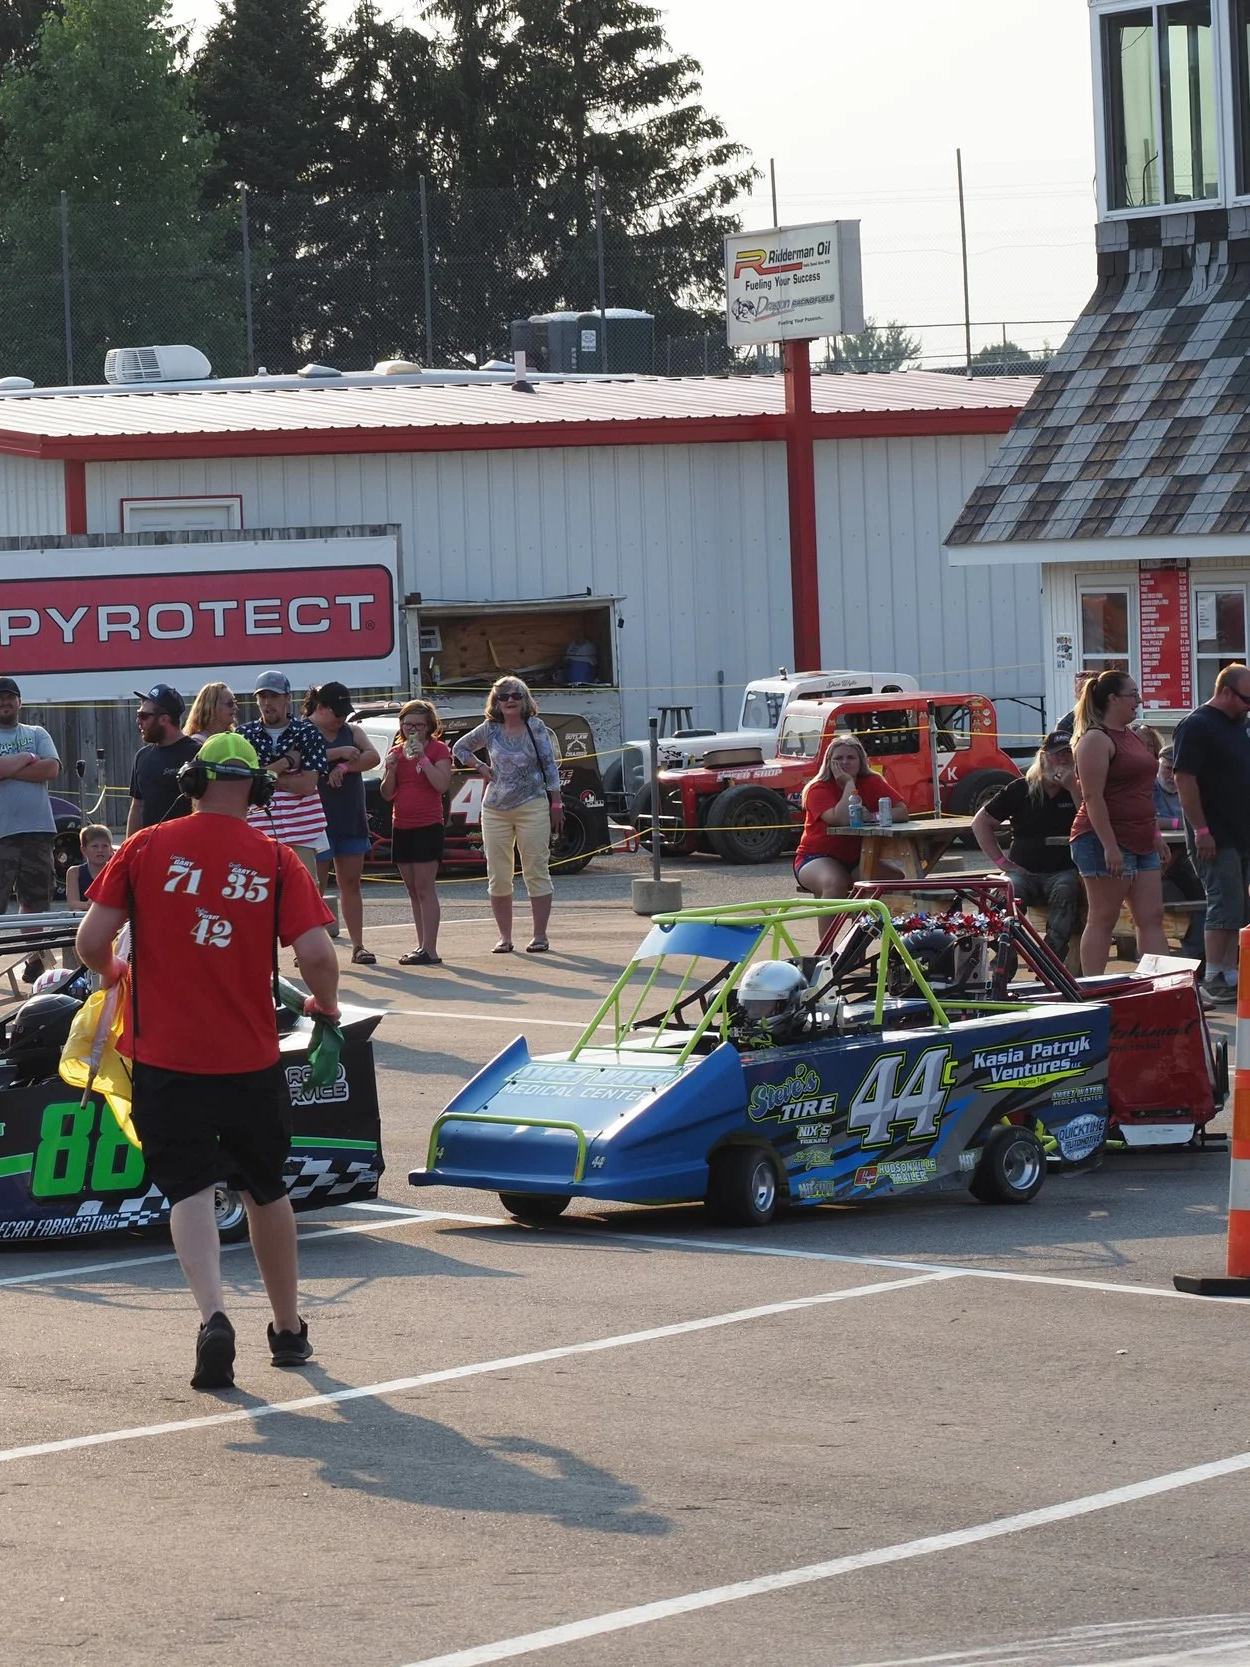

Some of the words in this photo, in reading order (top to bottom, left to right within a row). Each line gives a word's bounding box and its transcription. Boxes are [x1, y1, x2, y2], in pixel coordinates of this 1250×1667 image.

[768, 246, 815, 264] Ridderman
[817, 240, 831, 256] Oil
[745, 278, 772, 291] Fueling
[774, 276, 791, 287] Your
[793, 272, 821, 285] Success
[164, 865, 203, 896] 71
[221, 873, 271, 903] 35
[190, 919, 232, 948] 42
[973, 1048, 1024, 1069] Kasia
[1031, 1036, 1091, 1059] Patryk
[991, 1058, 1071, 1083] Ventures
[1070, 1061, 1083, 1069] LLC
[503, 1083, 573, 1098] MEDICAL
[749, 1064, 818, 1120] Steve's
[1053, 1098, 1078, 1106] MEDICAL
[1079, 1095, 1103, 1104] CENTER
[781, 1096, 835, 1121] TIRE
[797, 1123, 832, 1138] NIX'S
[1058, 1118, 1106, 1140] QUICKTIME
[1064, 1133, 1102, 1151] AUTOMOTIVE
[877, 1158, 937, 1174] HUDSONVILLE
[890, 1170, 928, 1184] TRAILER
[32, 1213, 120, 1237] FABRICATING
